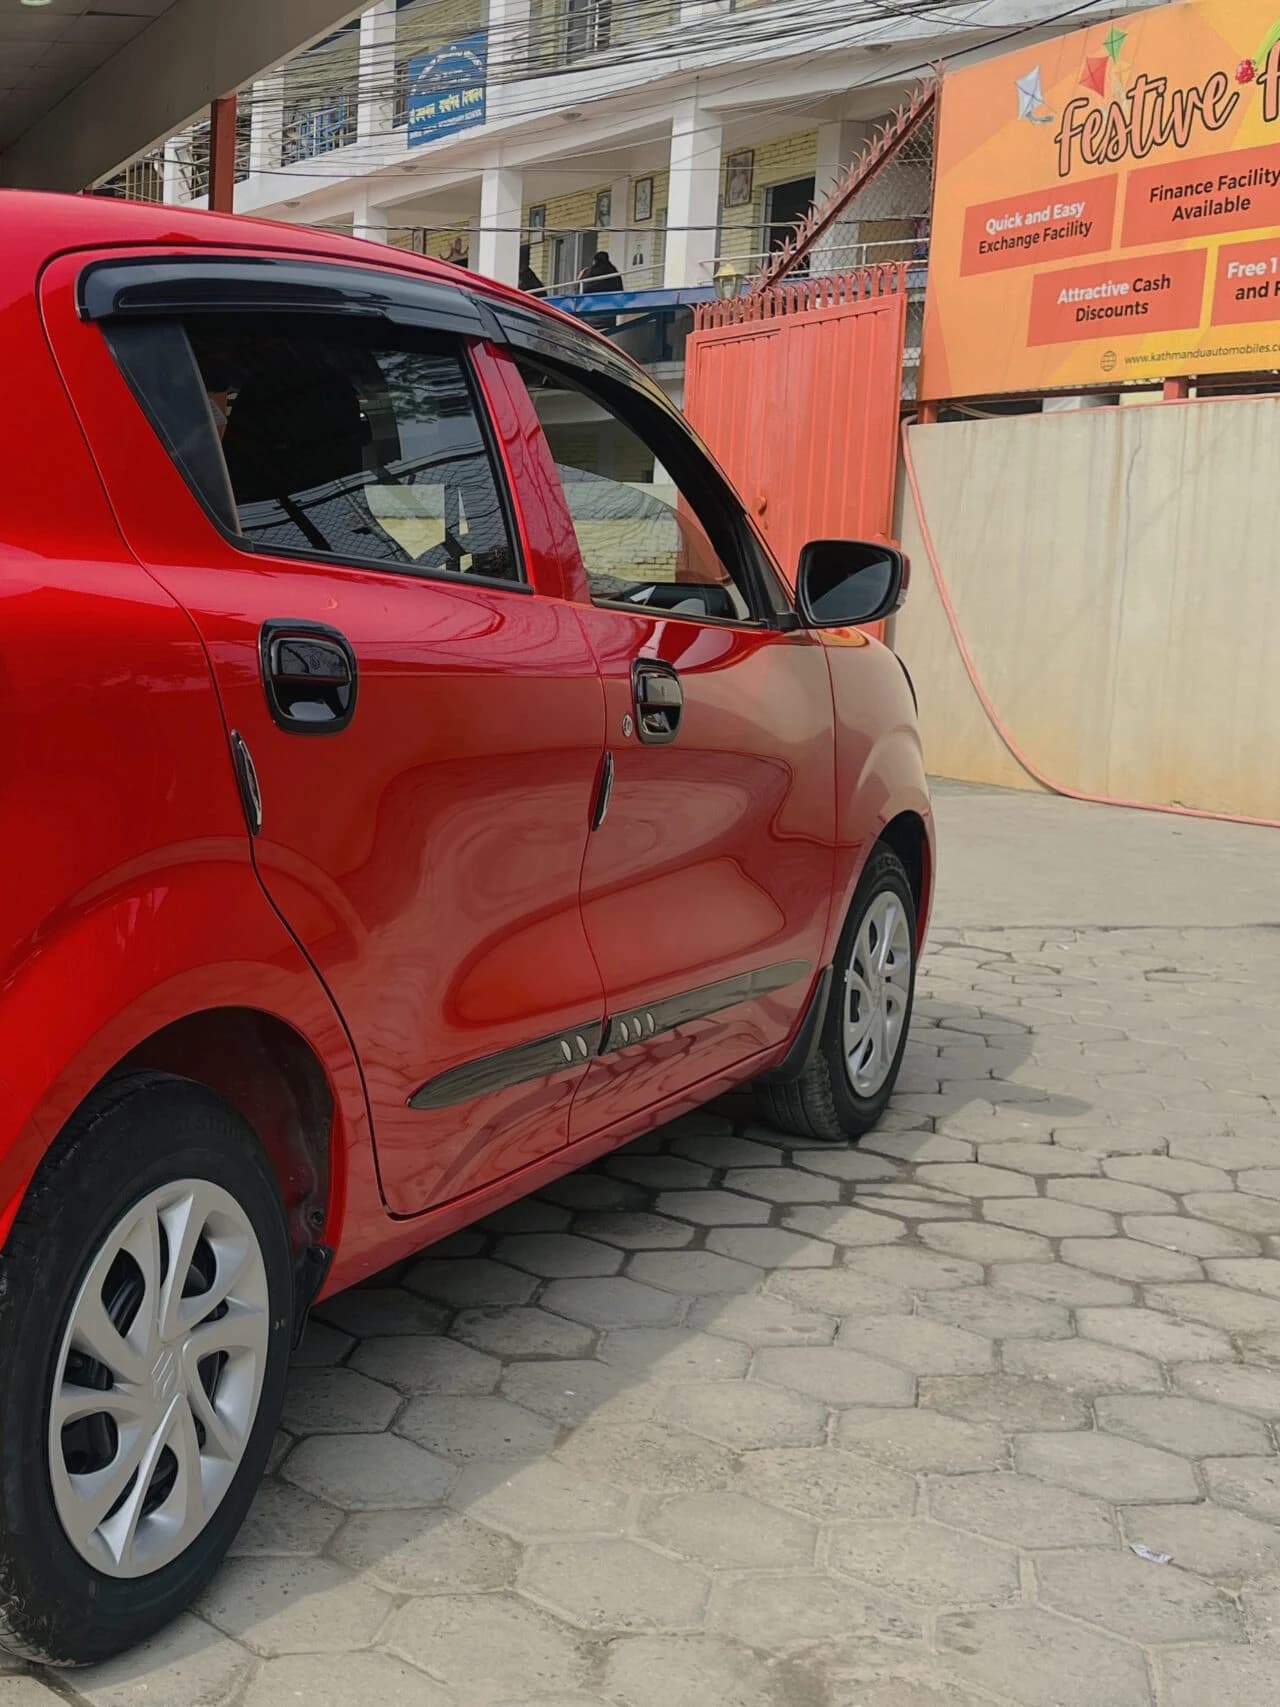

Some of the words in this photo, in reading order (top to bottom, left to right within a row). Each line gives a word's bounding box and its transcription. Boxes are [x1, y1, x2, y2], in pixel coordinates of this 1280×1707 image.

[1149, 184, 1214, 203] Finance
[1217, 167, 1280, 191] Facility
[985, 212, 1023, 235] Quick
[1024, 205, 1052, 225] and
[1053, 201, 1086, 220] Easy
[1171, 195, 1252, 222] Available
[978, 232, 1041, 255] Exchange
[1043, 219, 1093, 243] Facility
[1227, 261, 1267, 279] Free
[1056, 280, 1130, 304] Attractive
[1132, 274, 1171, 293] Cash
[1235, 280, 1270, 301] and
[1075, 301, 1150, 322] Discounts
